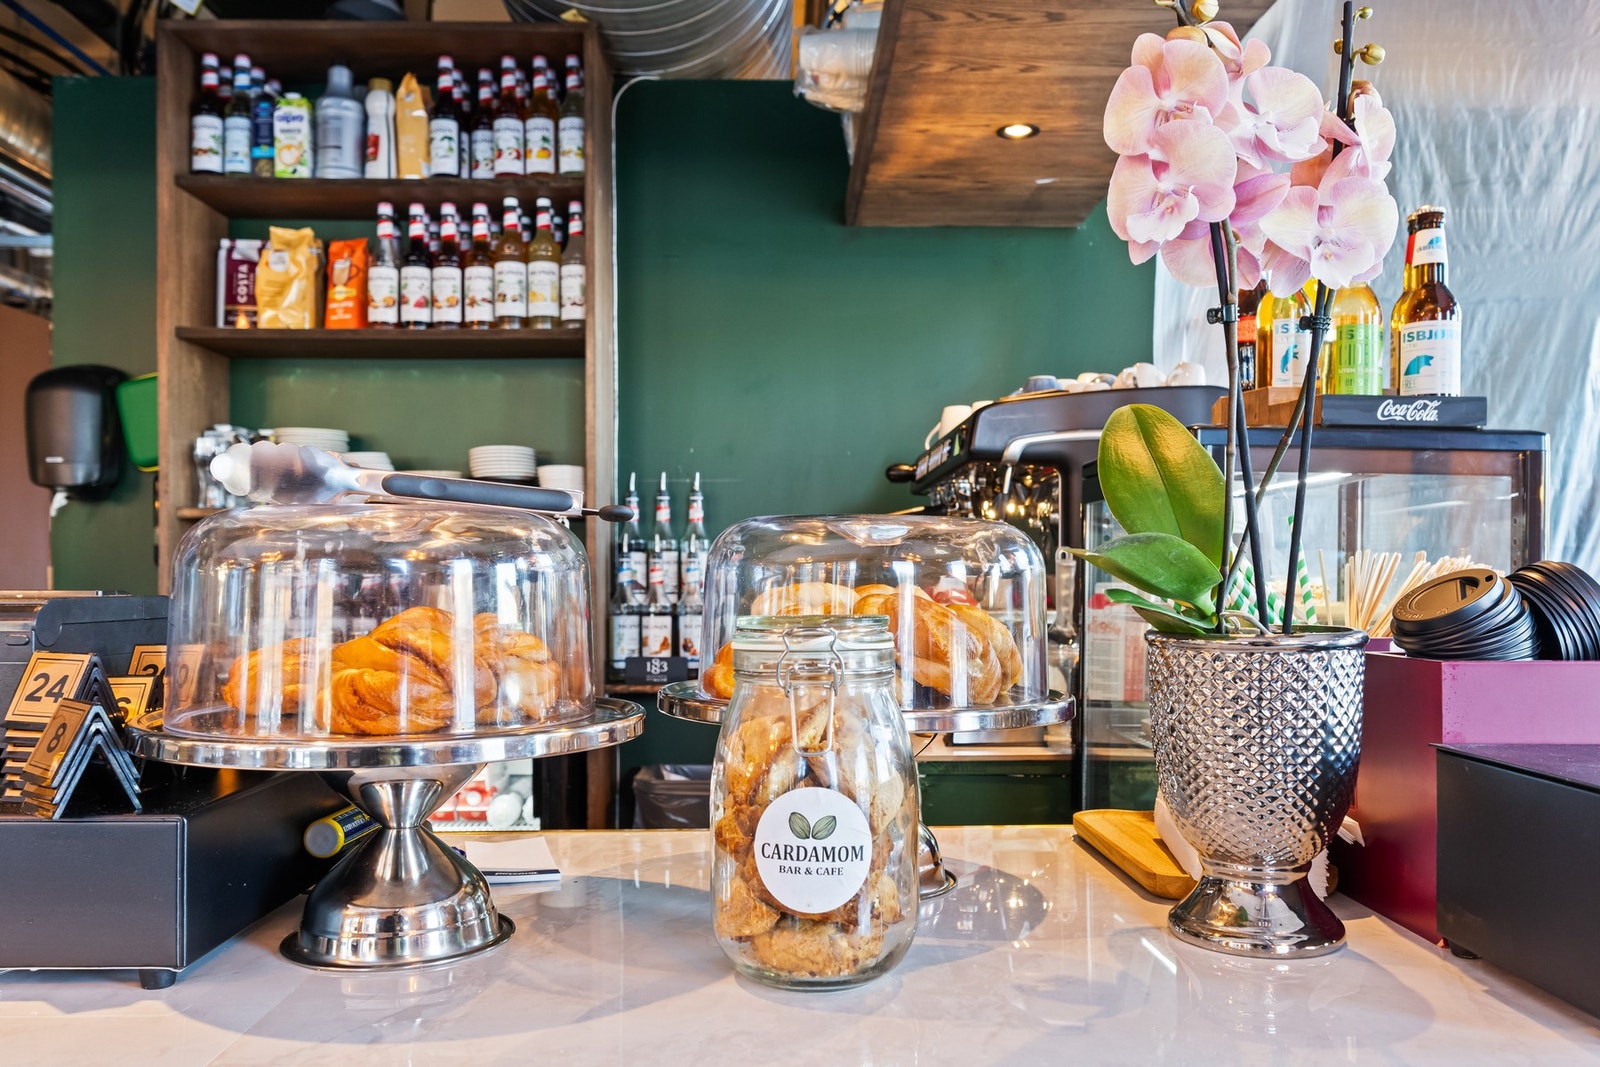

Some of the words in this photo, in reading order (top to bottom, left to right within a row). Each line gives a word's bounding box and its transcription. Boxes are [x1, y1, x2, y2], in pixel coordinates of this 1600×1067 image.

[237, 264, 249, 304] COSTA
[1376, 399, 1442, 421] Coca-Cola
[25, 672, 70, 704] 24
[46, 722, 68, 754] 8
[761, 842, 864, 863] CARDAMOM
[779, 865, 802, 875] BAR
[804, 867, 813, 876] &
[816, 867, 844, 876] CAFE
